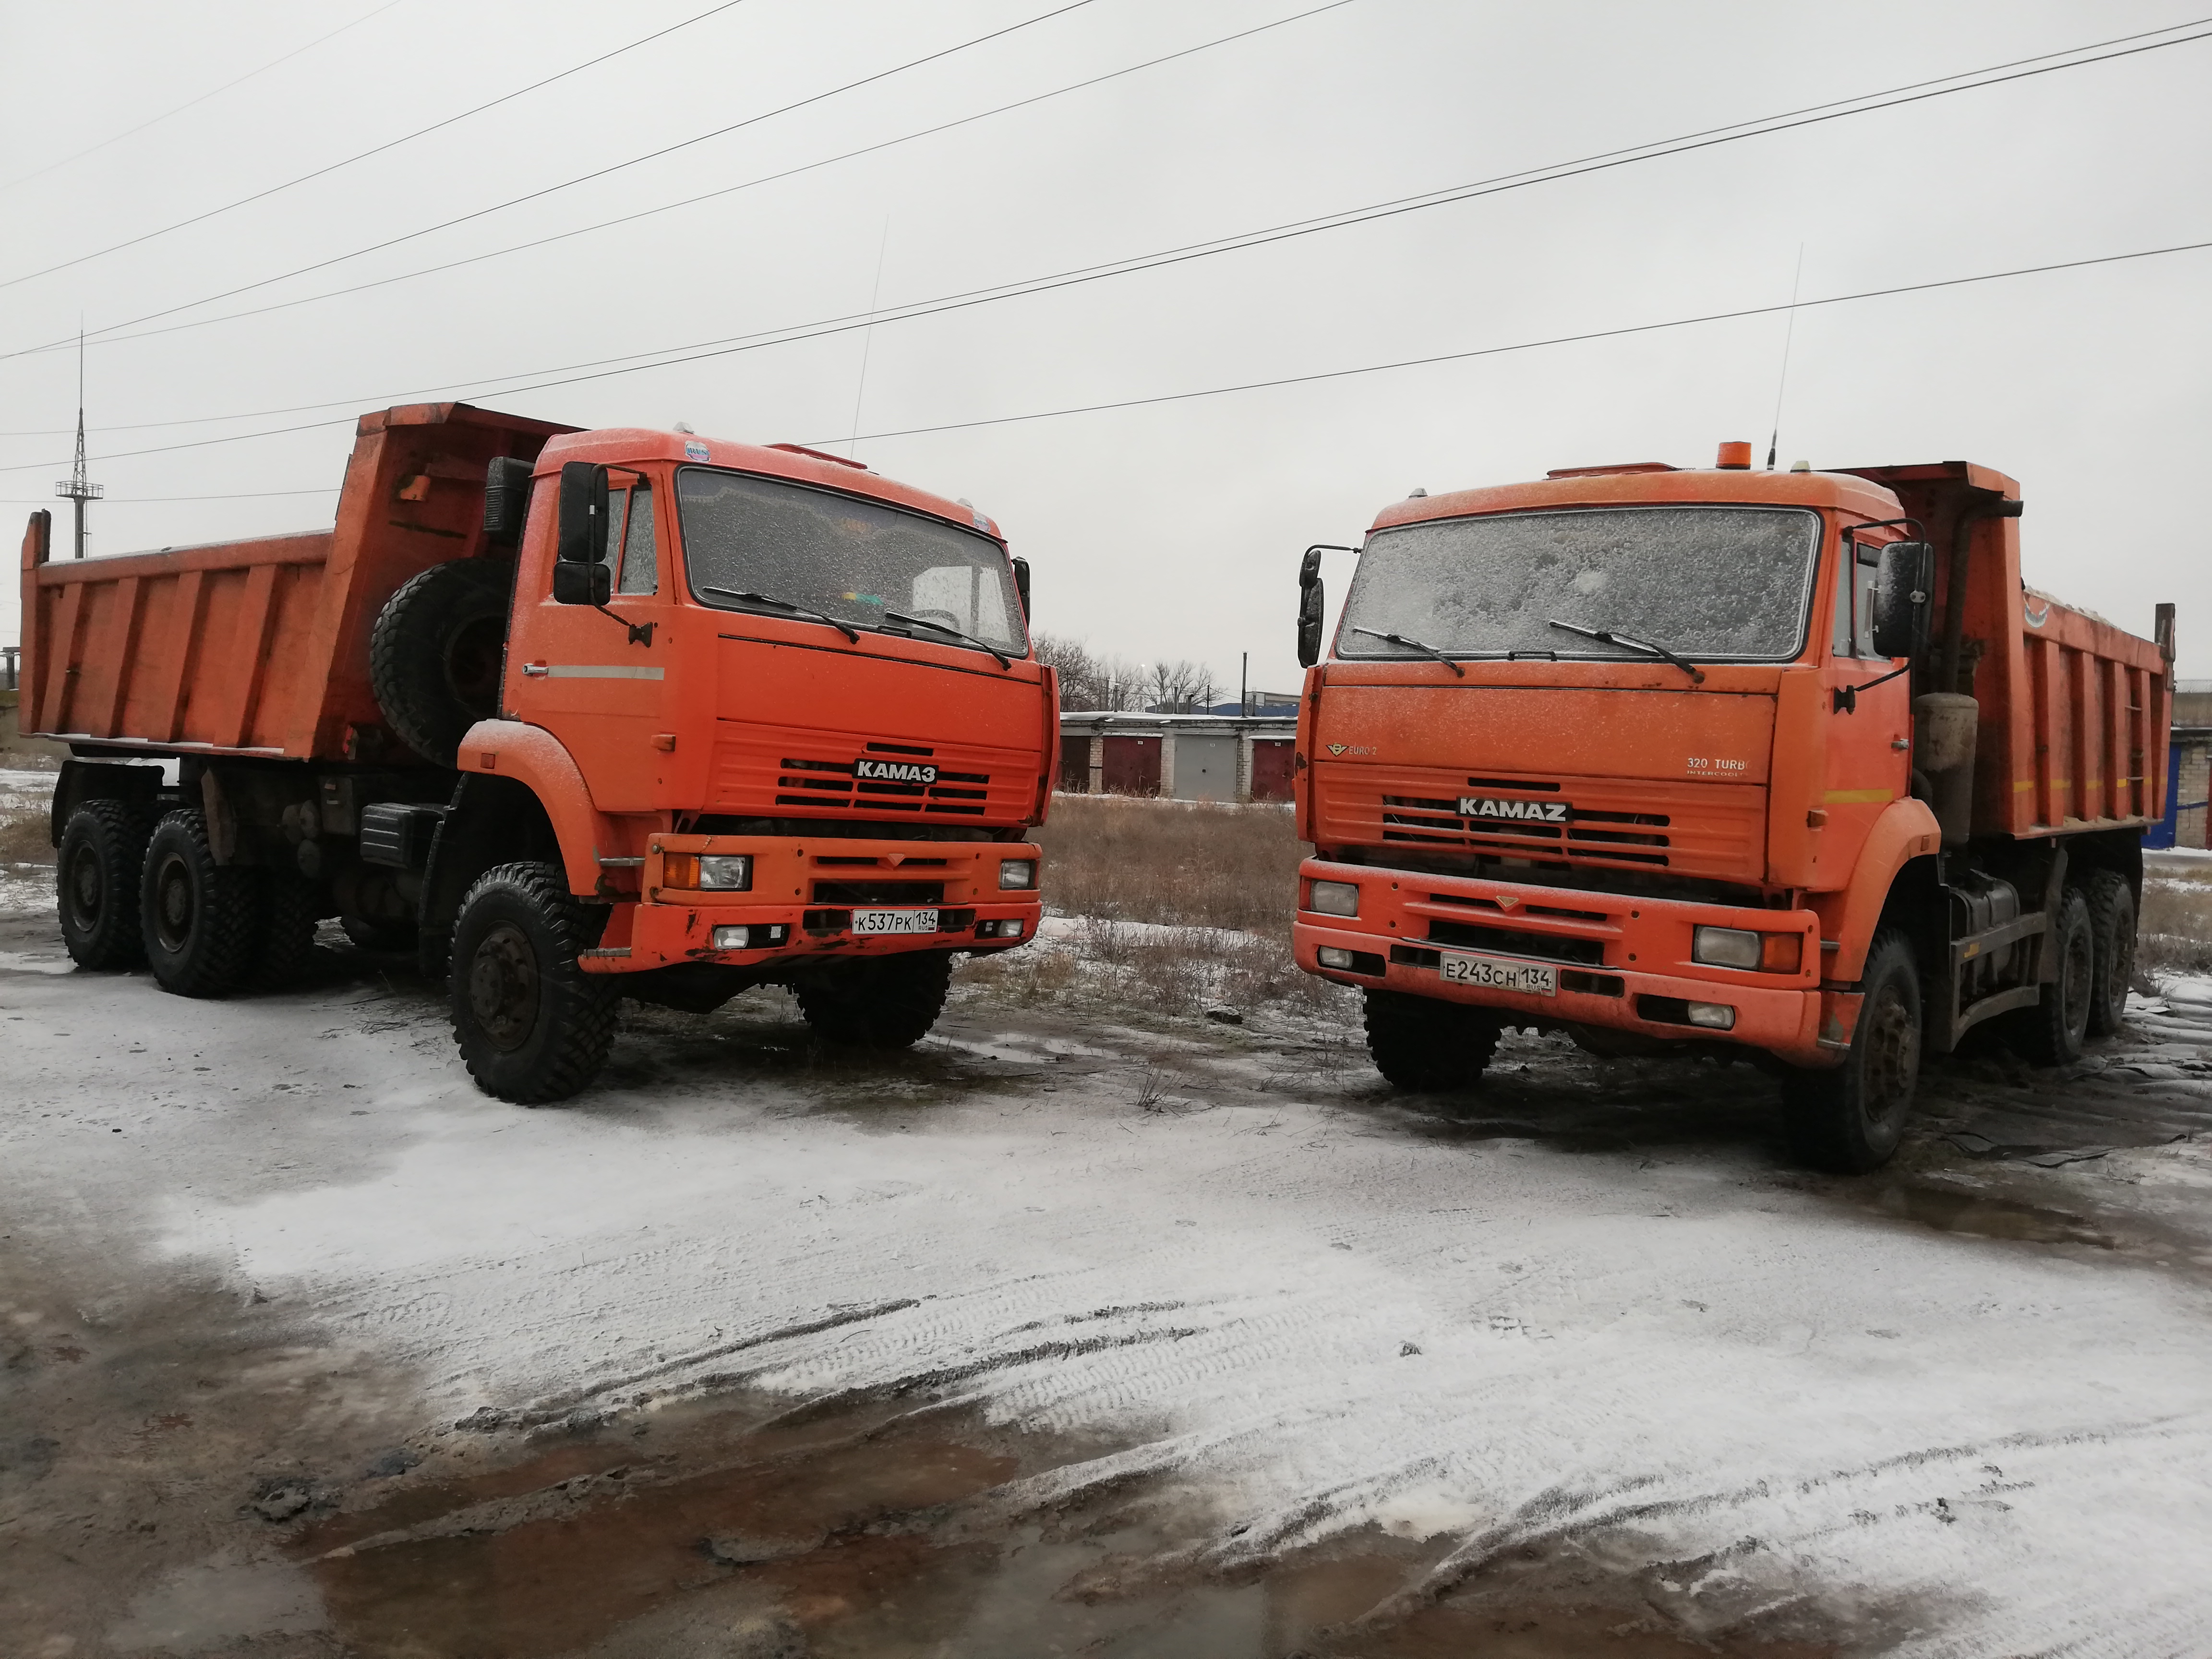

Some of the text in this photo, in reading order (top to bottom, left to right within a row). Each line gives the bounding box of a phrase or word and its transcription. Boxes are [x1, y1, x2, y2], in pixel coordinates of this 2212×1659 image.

[1349, 745, 1377, 755] EURO 2
[1687, 757, 1708, 768] 320
[858, 761, 936, 782] КАМАЗ
[1460, 798, 1566, 821] KAMAZ
[916, 912, 936, 925] 134
[1521, 968, 1550, 986] 134
